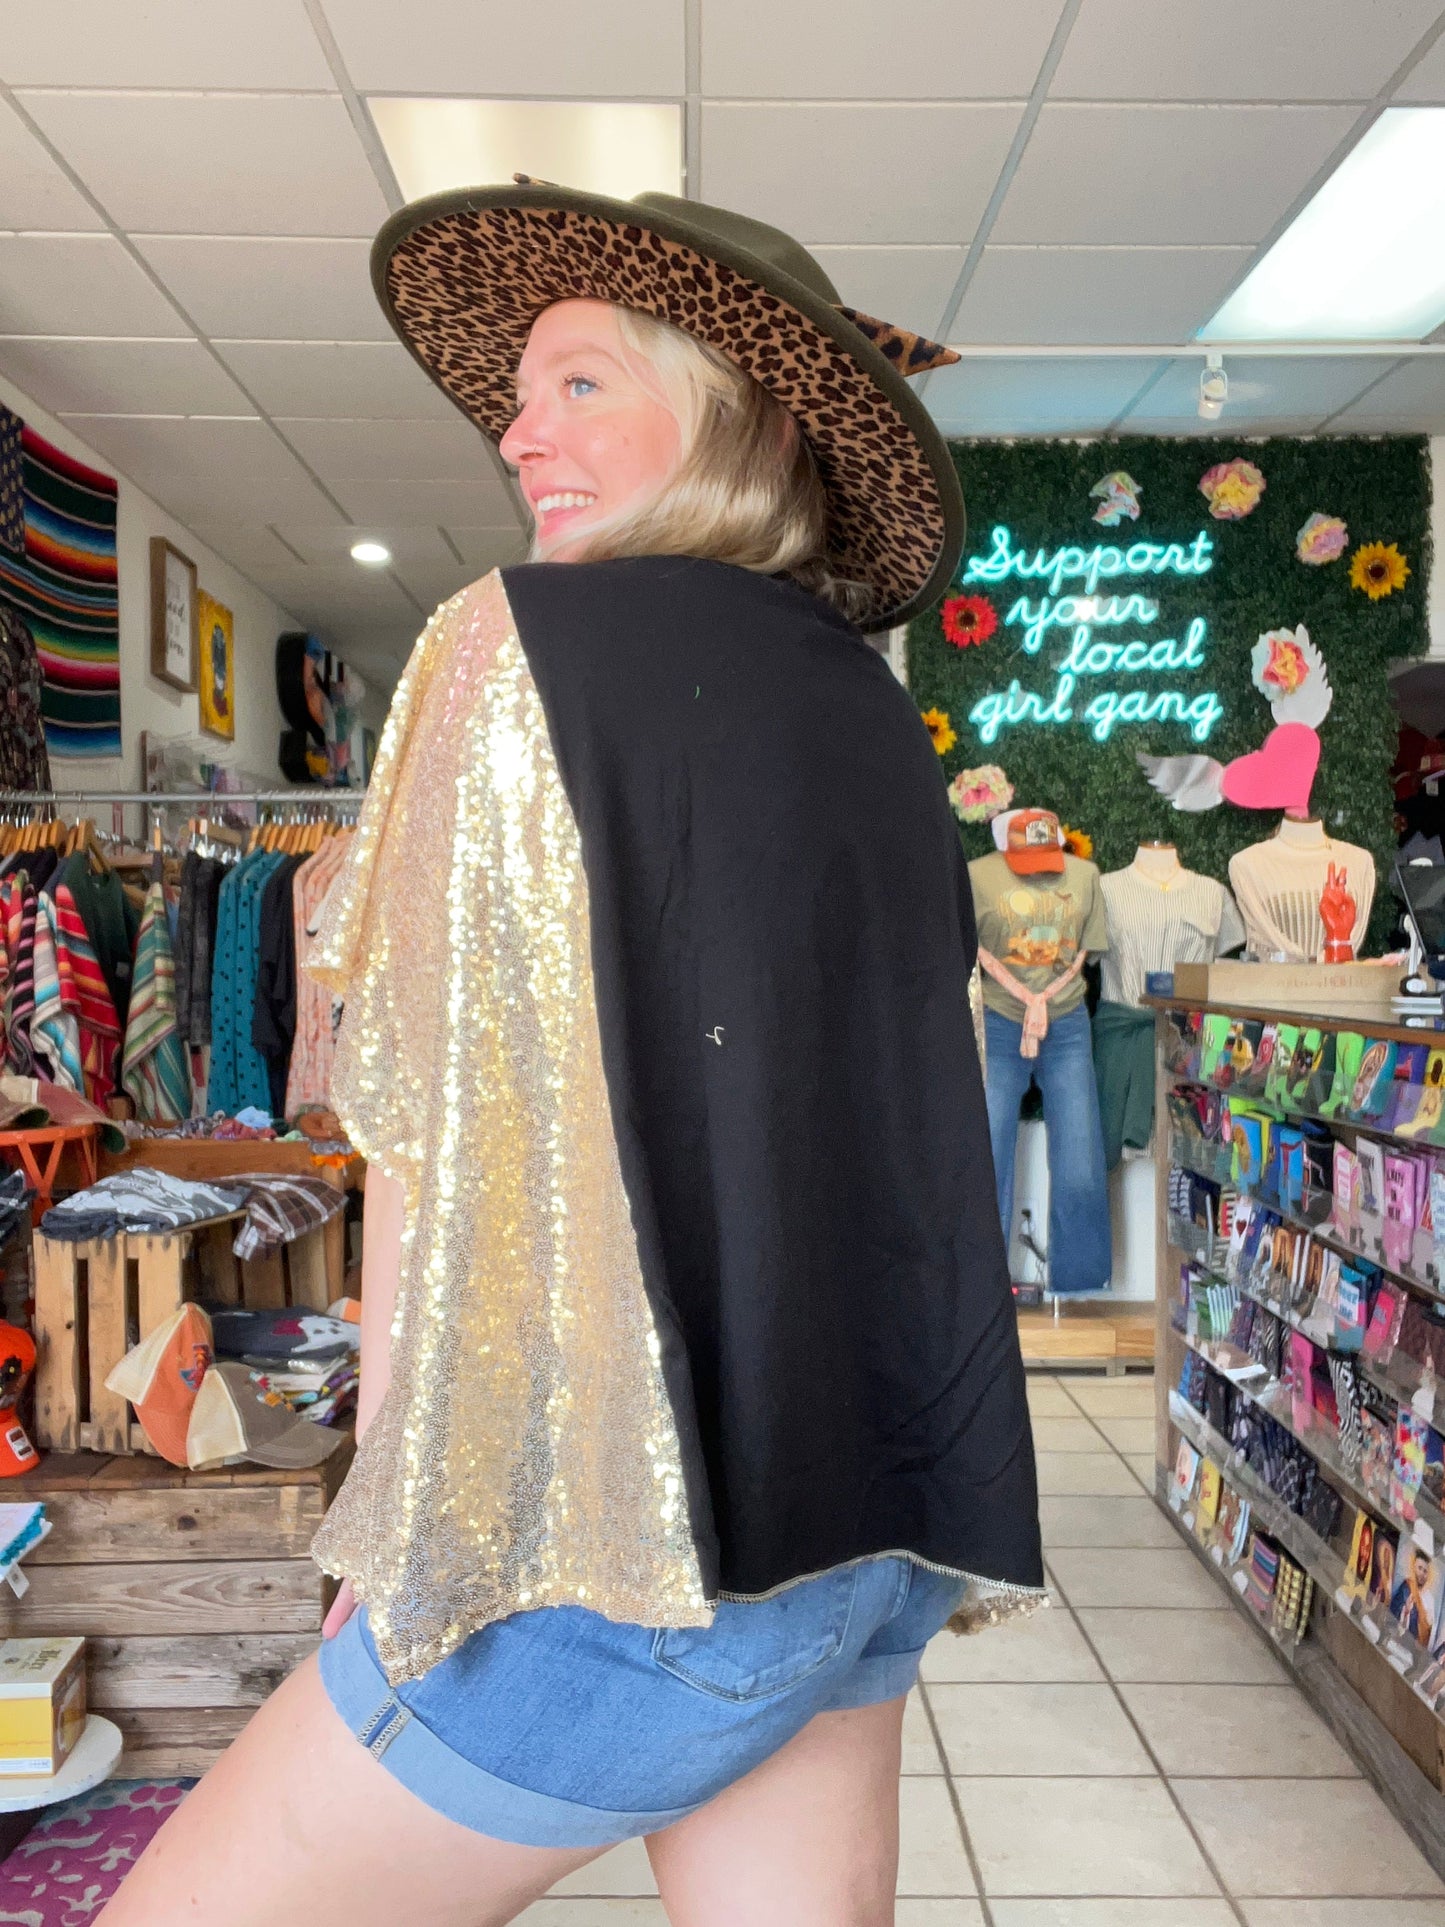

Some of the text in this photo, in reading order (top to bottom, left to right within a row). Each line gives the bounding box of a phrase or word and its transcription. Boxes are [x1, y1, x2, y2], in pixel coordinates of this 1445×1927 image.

[962, 525, 1213, 595] Support
[1004, 594, 1156, 653] your
[1058, 616, 1206, 674] local
[968, 671, 1224, 744] girl gang
